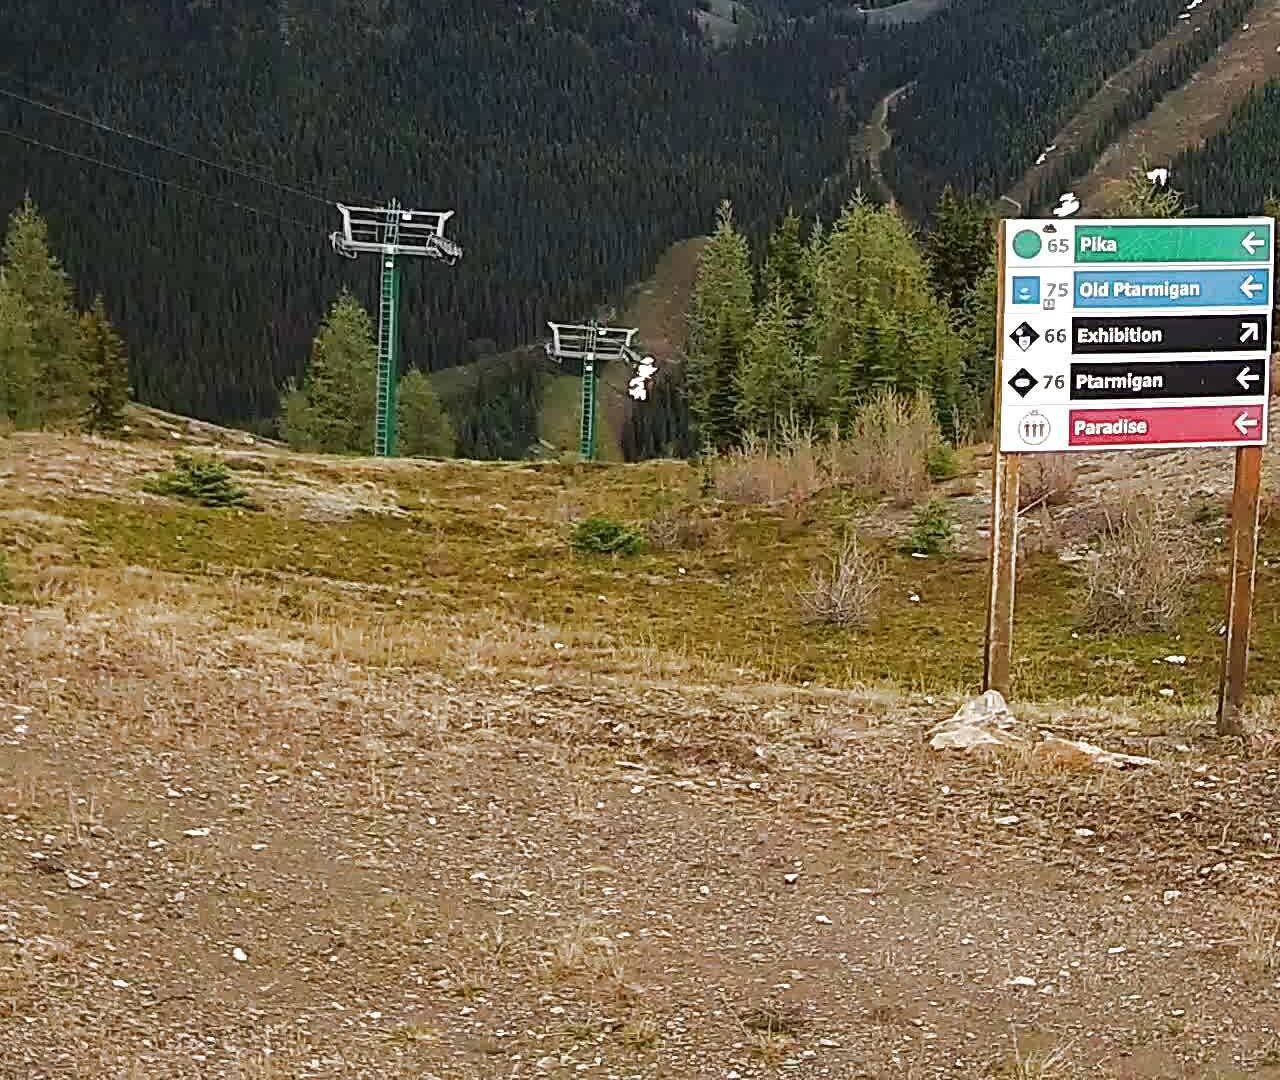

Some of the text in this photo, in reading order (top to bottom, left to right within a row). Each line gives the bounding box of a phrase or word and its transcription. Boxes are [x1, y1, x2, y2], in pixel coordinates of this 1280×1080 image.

[1047, 236, 1117, 253] 65 Pika
[1046, 281, 1200, 301] 75 Old Ptarmigan
[1044, 327, 1162, 343] 66 Exhibition
[1043, 372, 1163, 391] 76 Ptarmigan
[1074, 419, 1148, 436] Paradise
